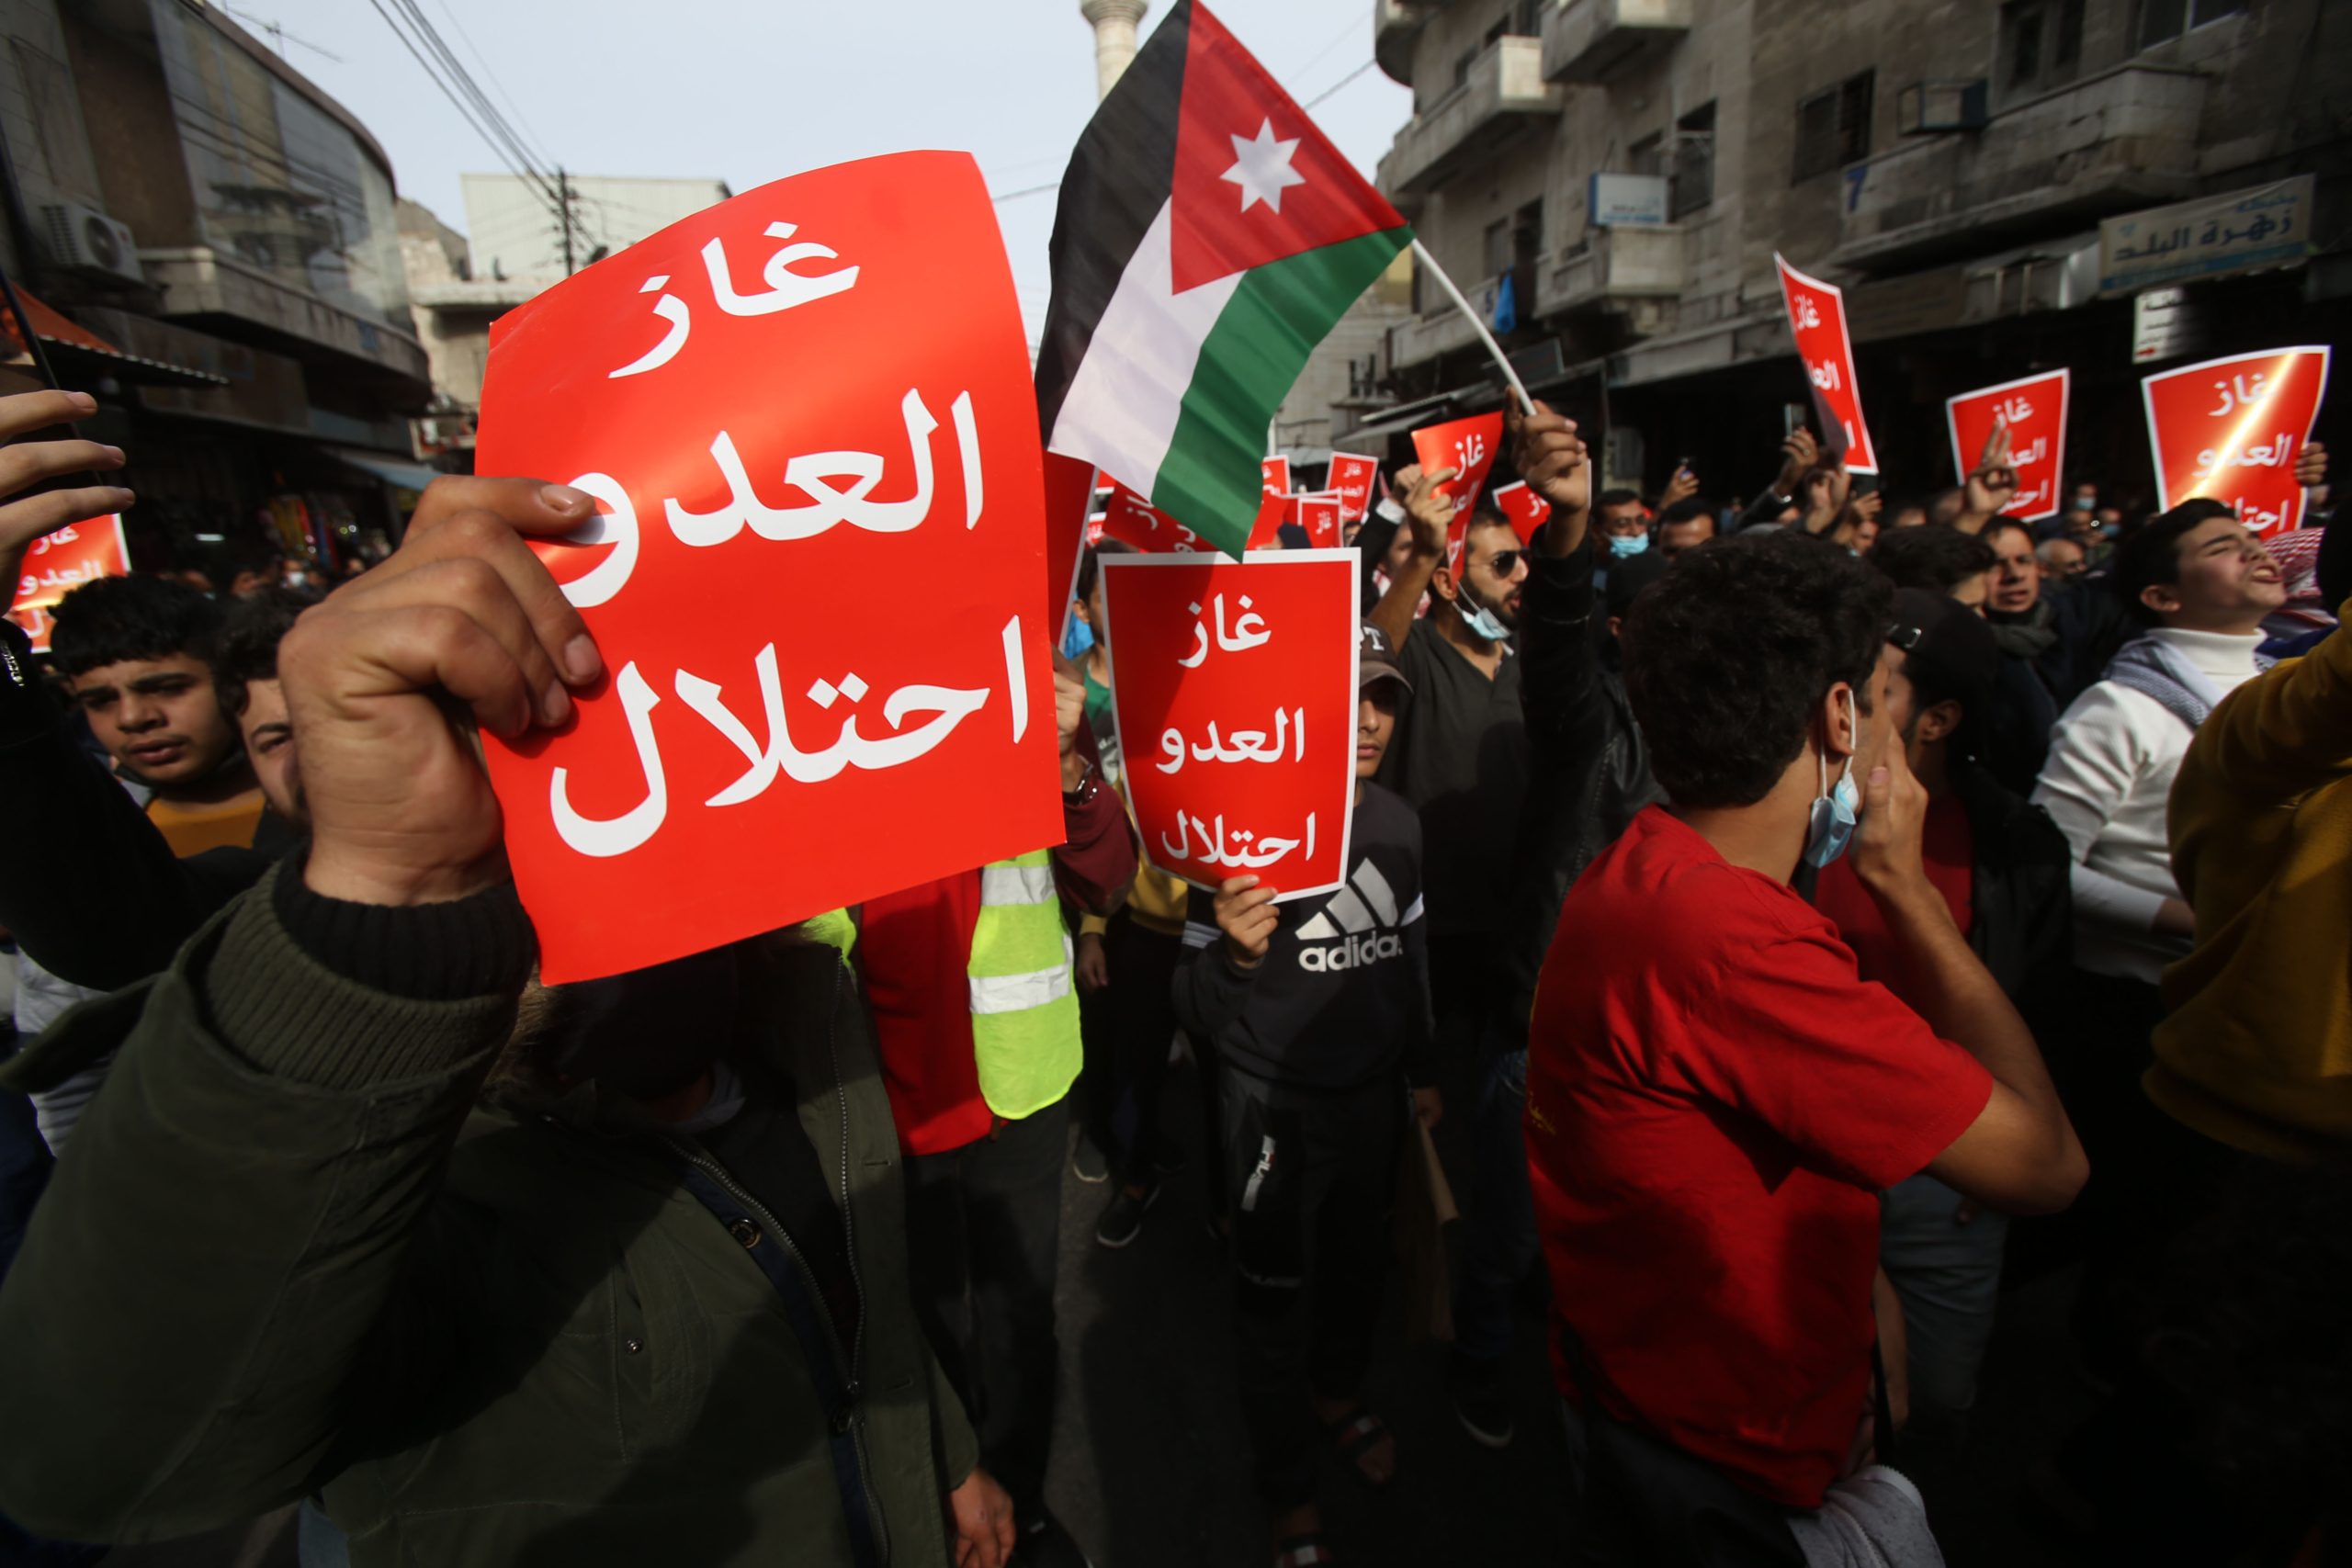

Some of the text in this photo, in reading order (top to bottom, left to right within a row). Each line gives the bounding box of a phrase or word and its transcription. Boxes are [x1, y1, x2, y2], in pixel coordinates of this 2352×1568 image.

[608, 221, 860, 379] غاز
[1453, 433, 1485, 481] غاز
[560, 388, 985, 609] العدو
[1177, 592, 1272, 669] غاز
[551, 615, 1029, 858] احتلال
[1155, 705, 1305, 774] العدو
[1161, 808, 1316, 869] احتلال
